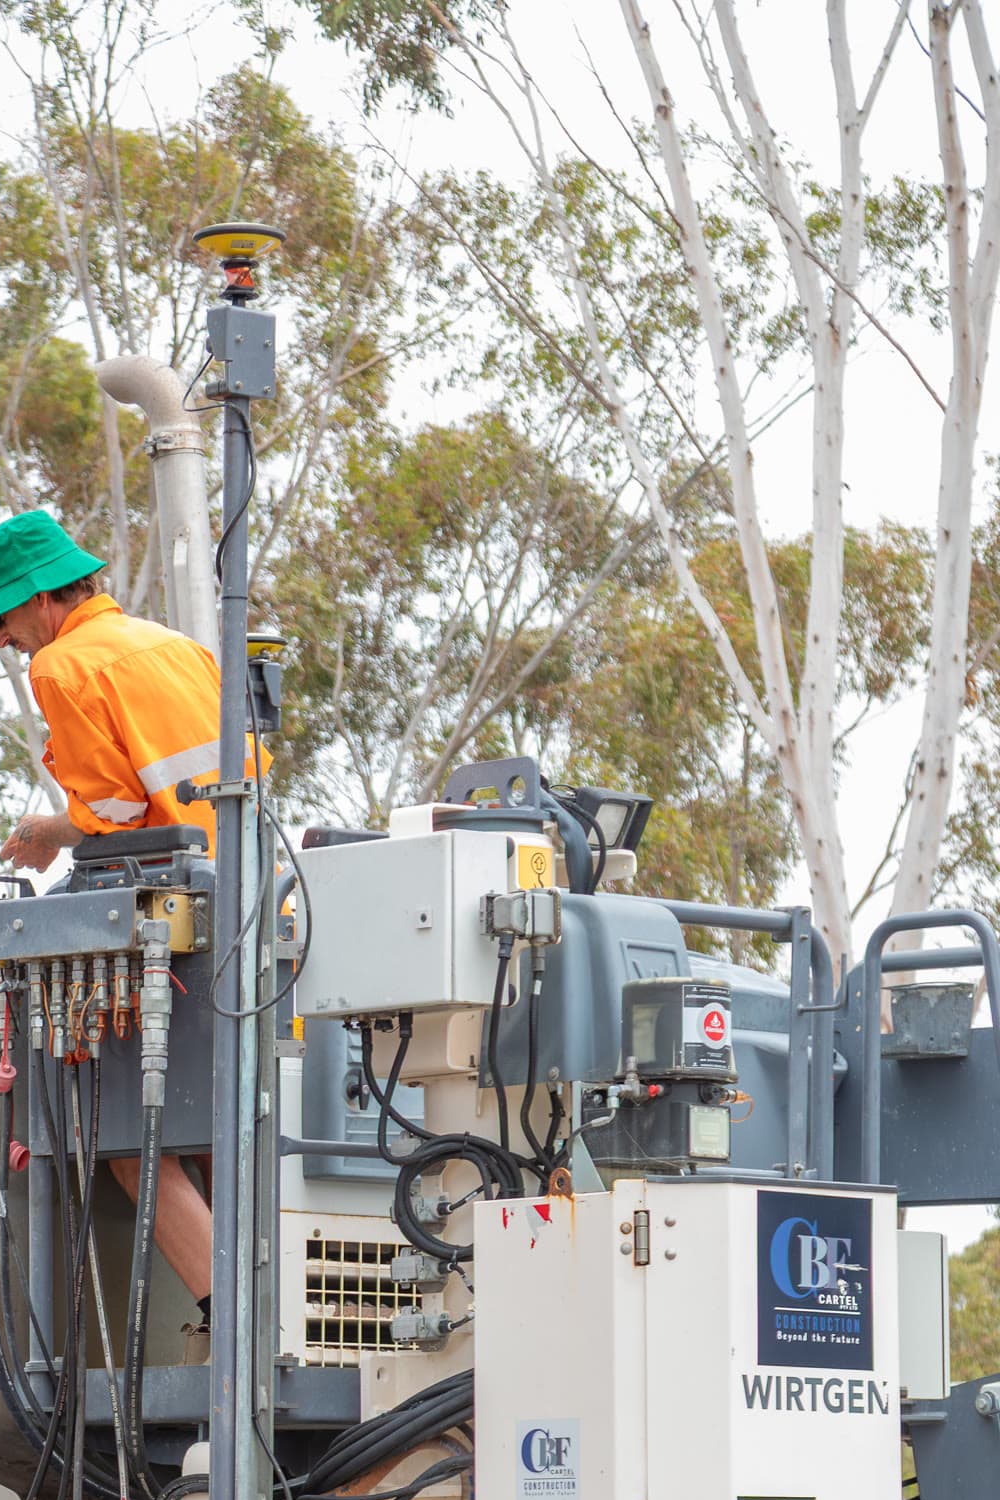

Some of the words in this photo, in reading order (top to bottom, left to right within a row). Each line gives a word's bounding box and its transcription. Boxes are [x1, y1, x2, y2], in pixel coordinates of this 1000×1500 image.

[818, 1294, 858, 1306] CARTEL
[775, 1313, 861, 1334] CONSTRUCTION
[776, 1330, 808, 1343] Beyond
[811, 1332, 827, 1343] the
[831, 1333, 861, 1345] Future
[742, 1374, 889, 1415] WIRTGEN
[521, 1428, 571, 1473] CBF
[523, 1481, 576, 1491] CONSTRUCTION
